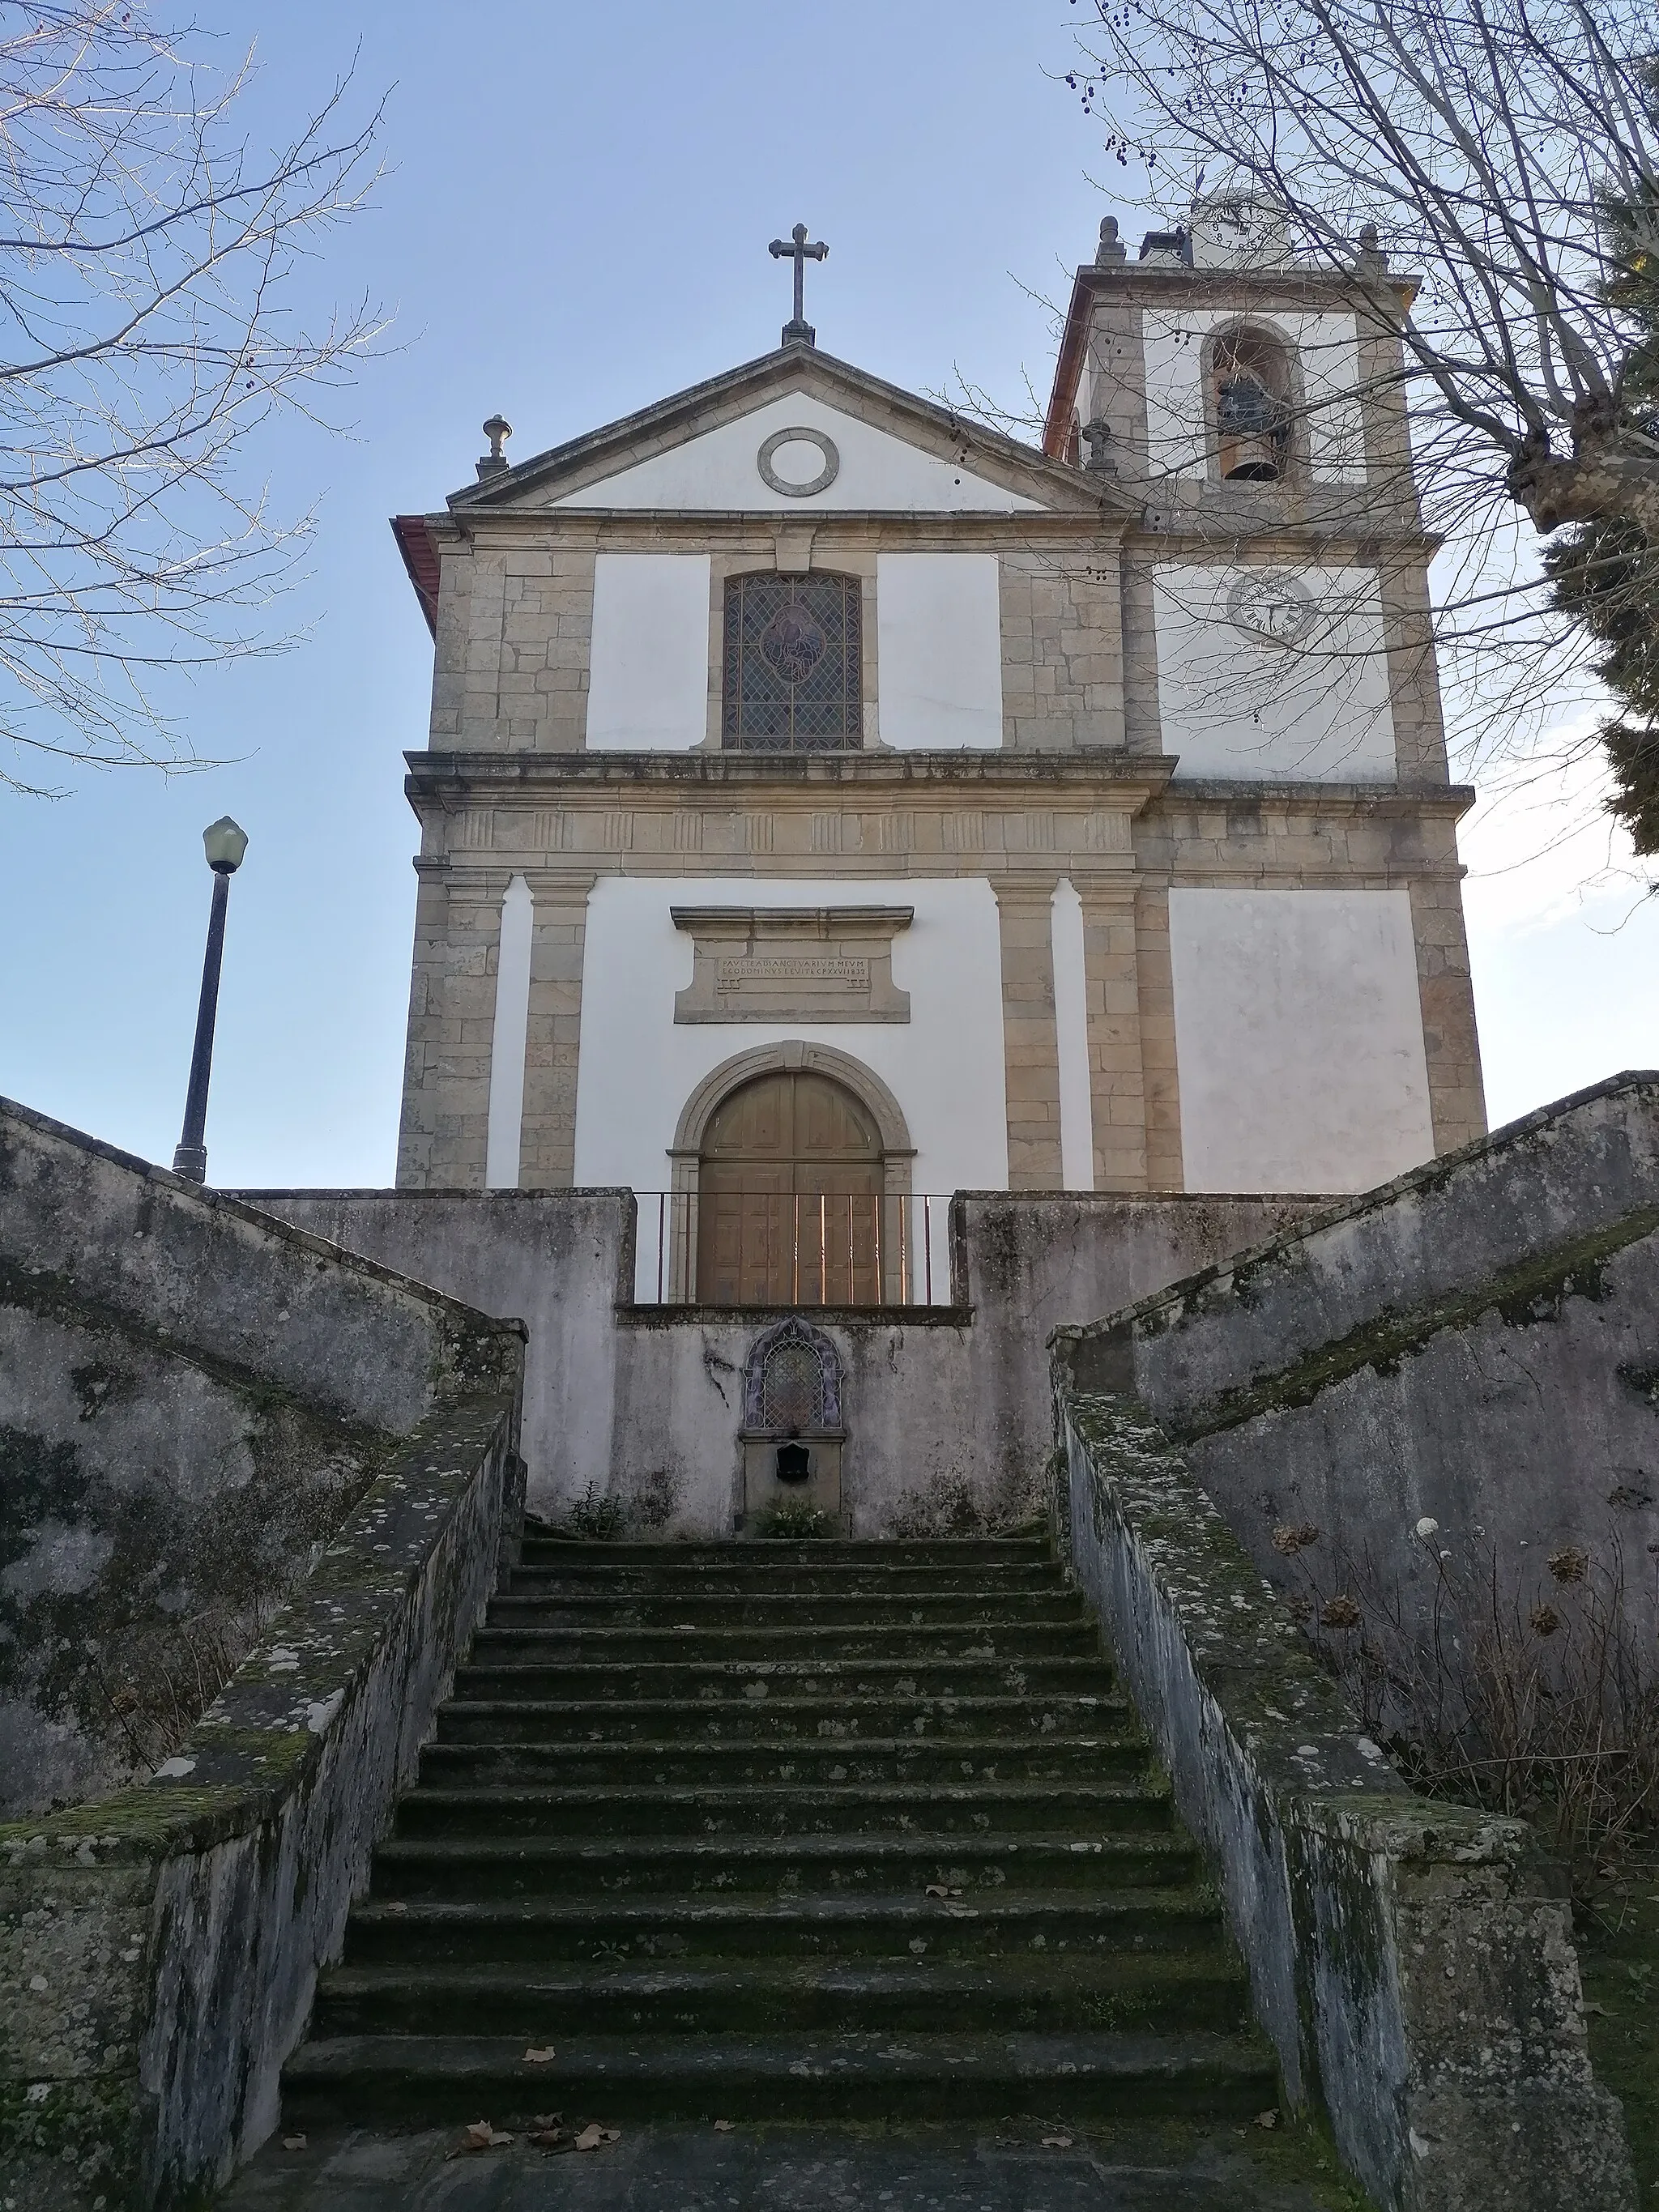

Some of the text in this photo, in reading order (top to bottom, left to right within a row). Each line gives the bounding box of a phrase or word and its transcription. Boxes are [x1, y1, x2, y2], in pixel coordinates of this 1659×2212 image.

[1212, 224, 1218, 232] 9
[1217, 232, 1223, 241] 8
[1251, 241, 1257, 249] 5
